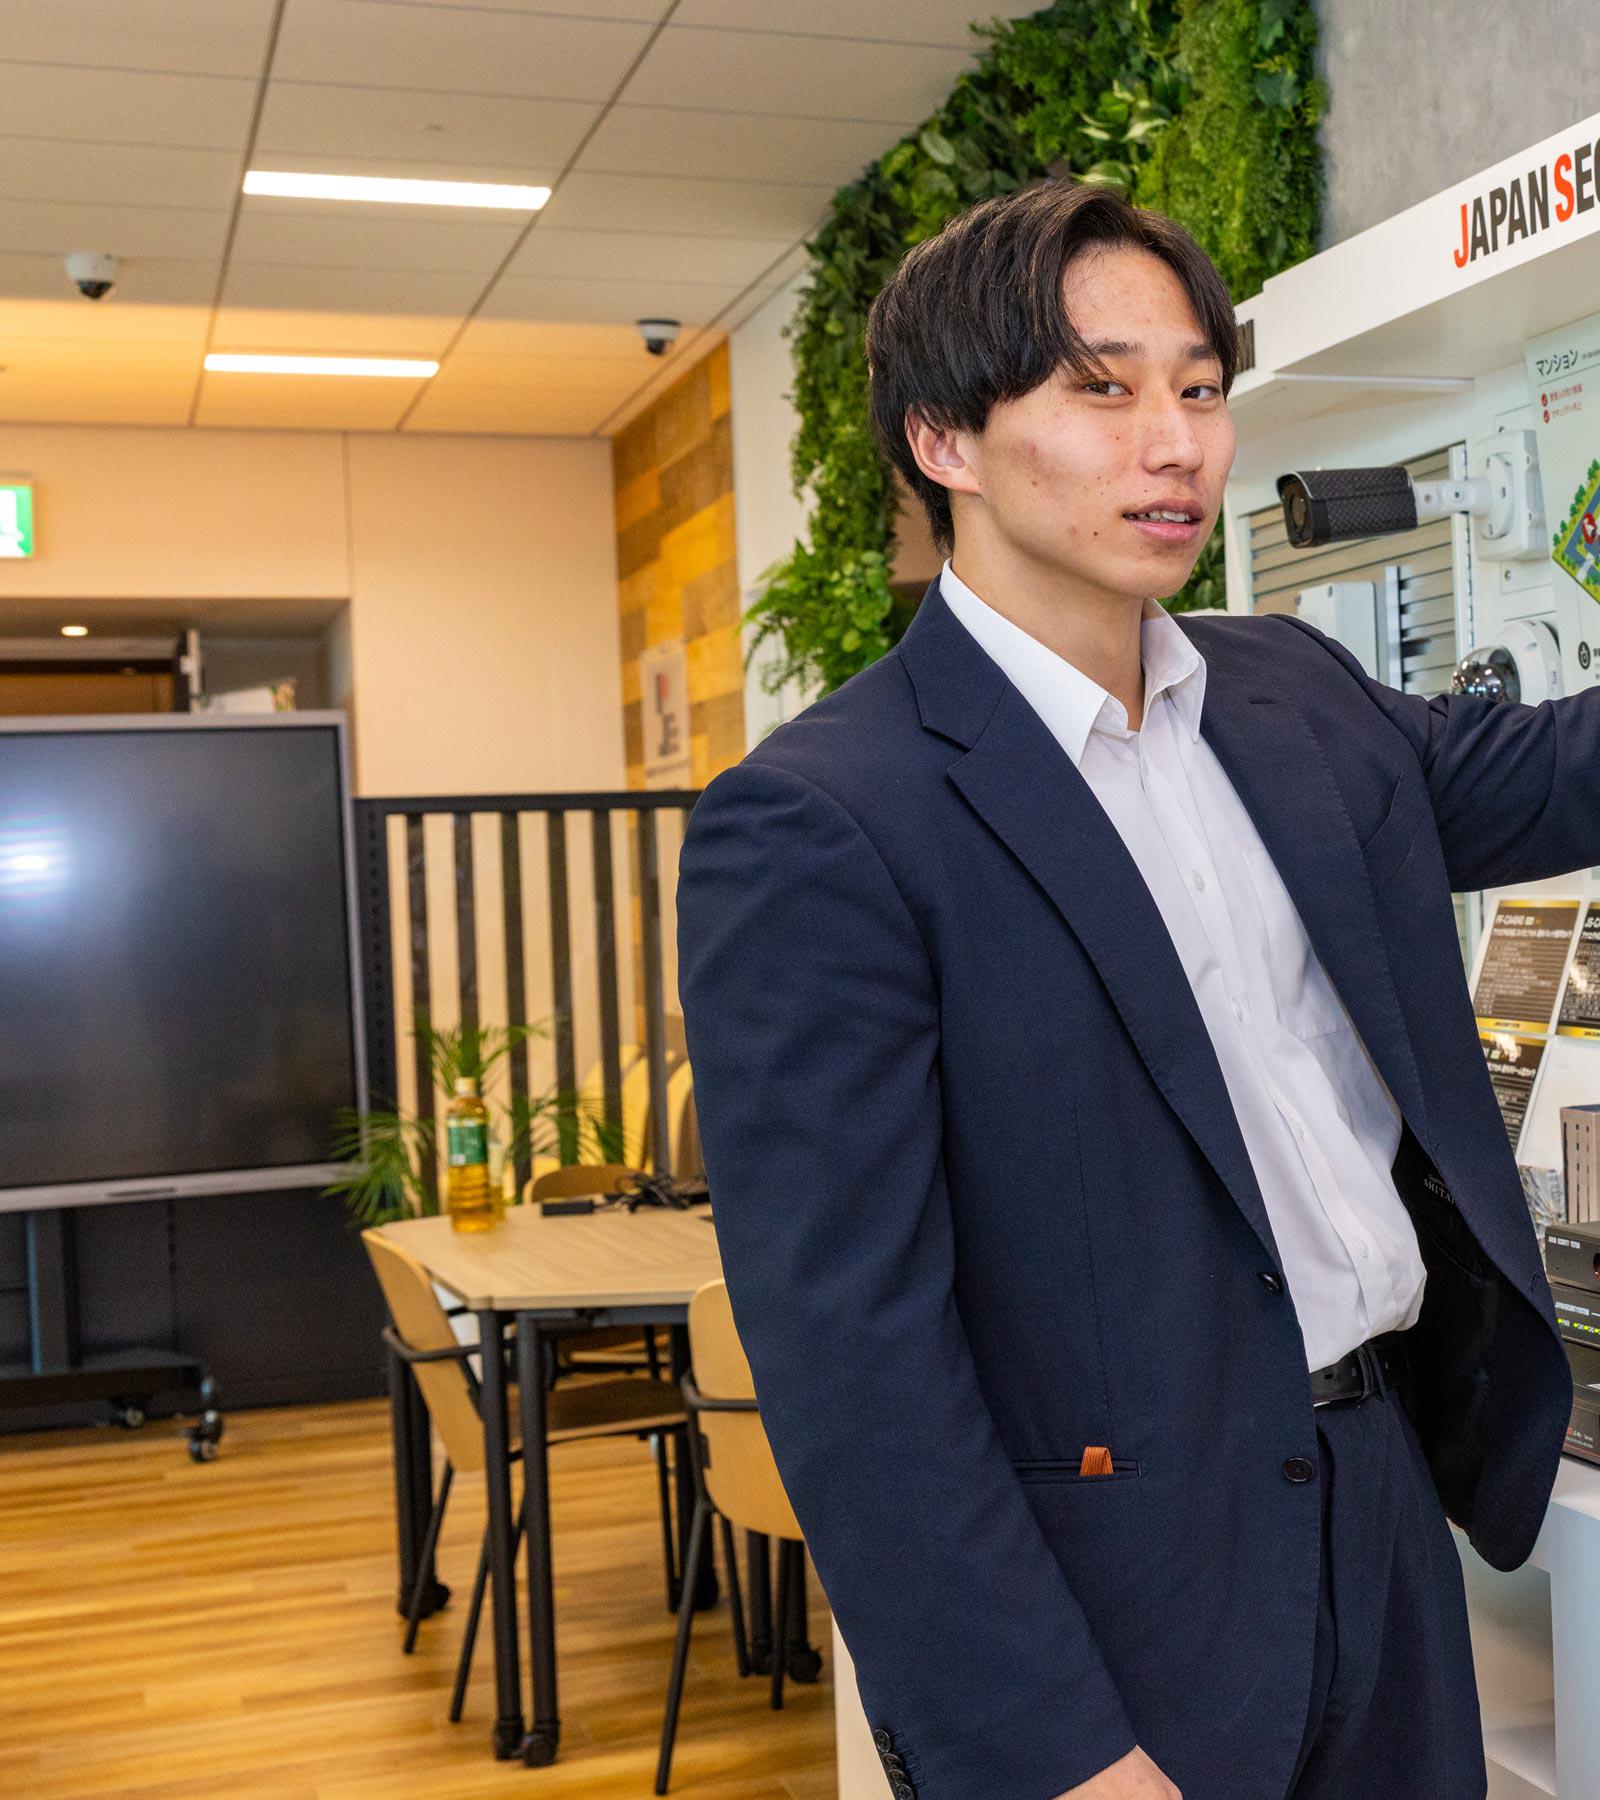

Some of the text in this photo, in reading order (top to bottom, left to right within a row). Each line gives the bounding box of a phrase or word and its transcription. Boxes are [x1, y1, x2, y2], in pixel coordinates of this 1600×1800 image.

[1453, 164, 1550, 269] JAPAN
[1536, 350, 1578, 376] マンション
